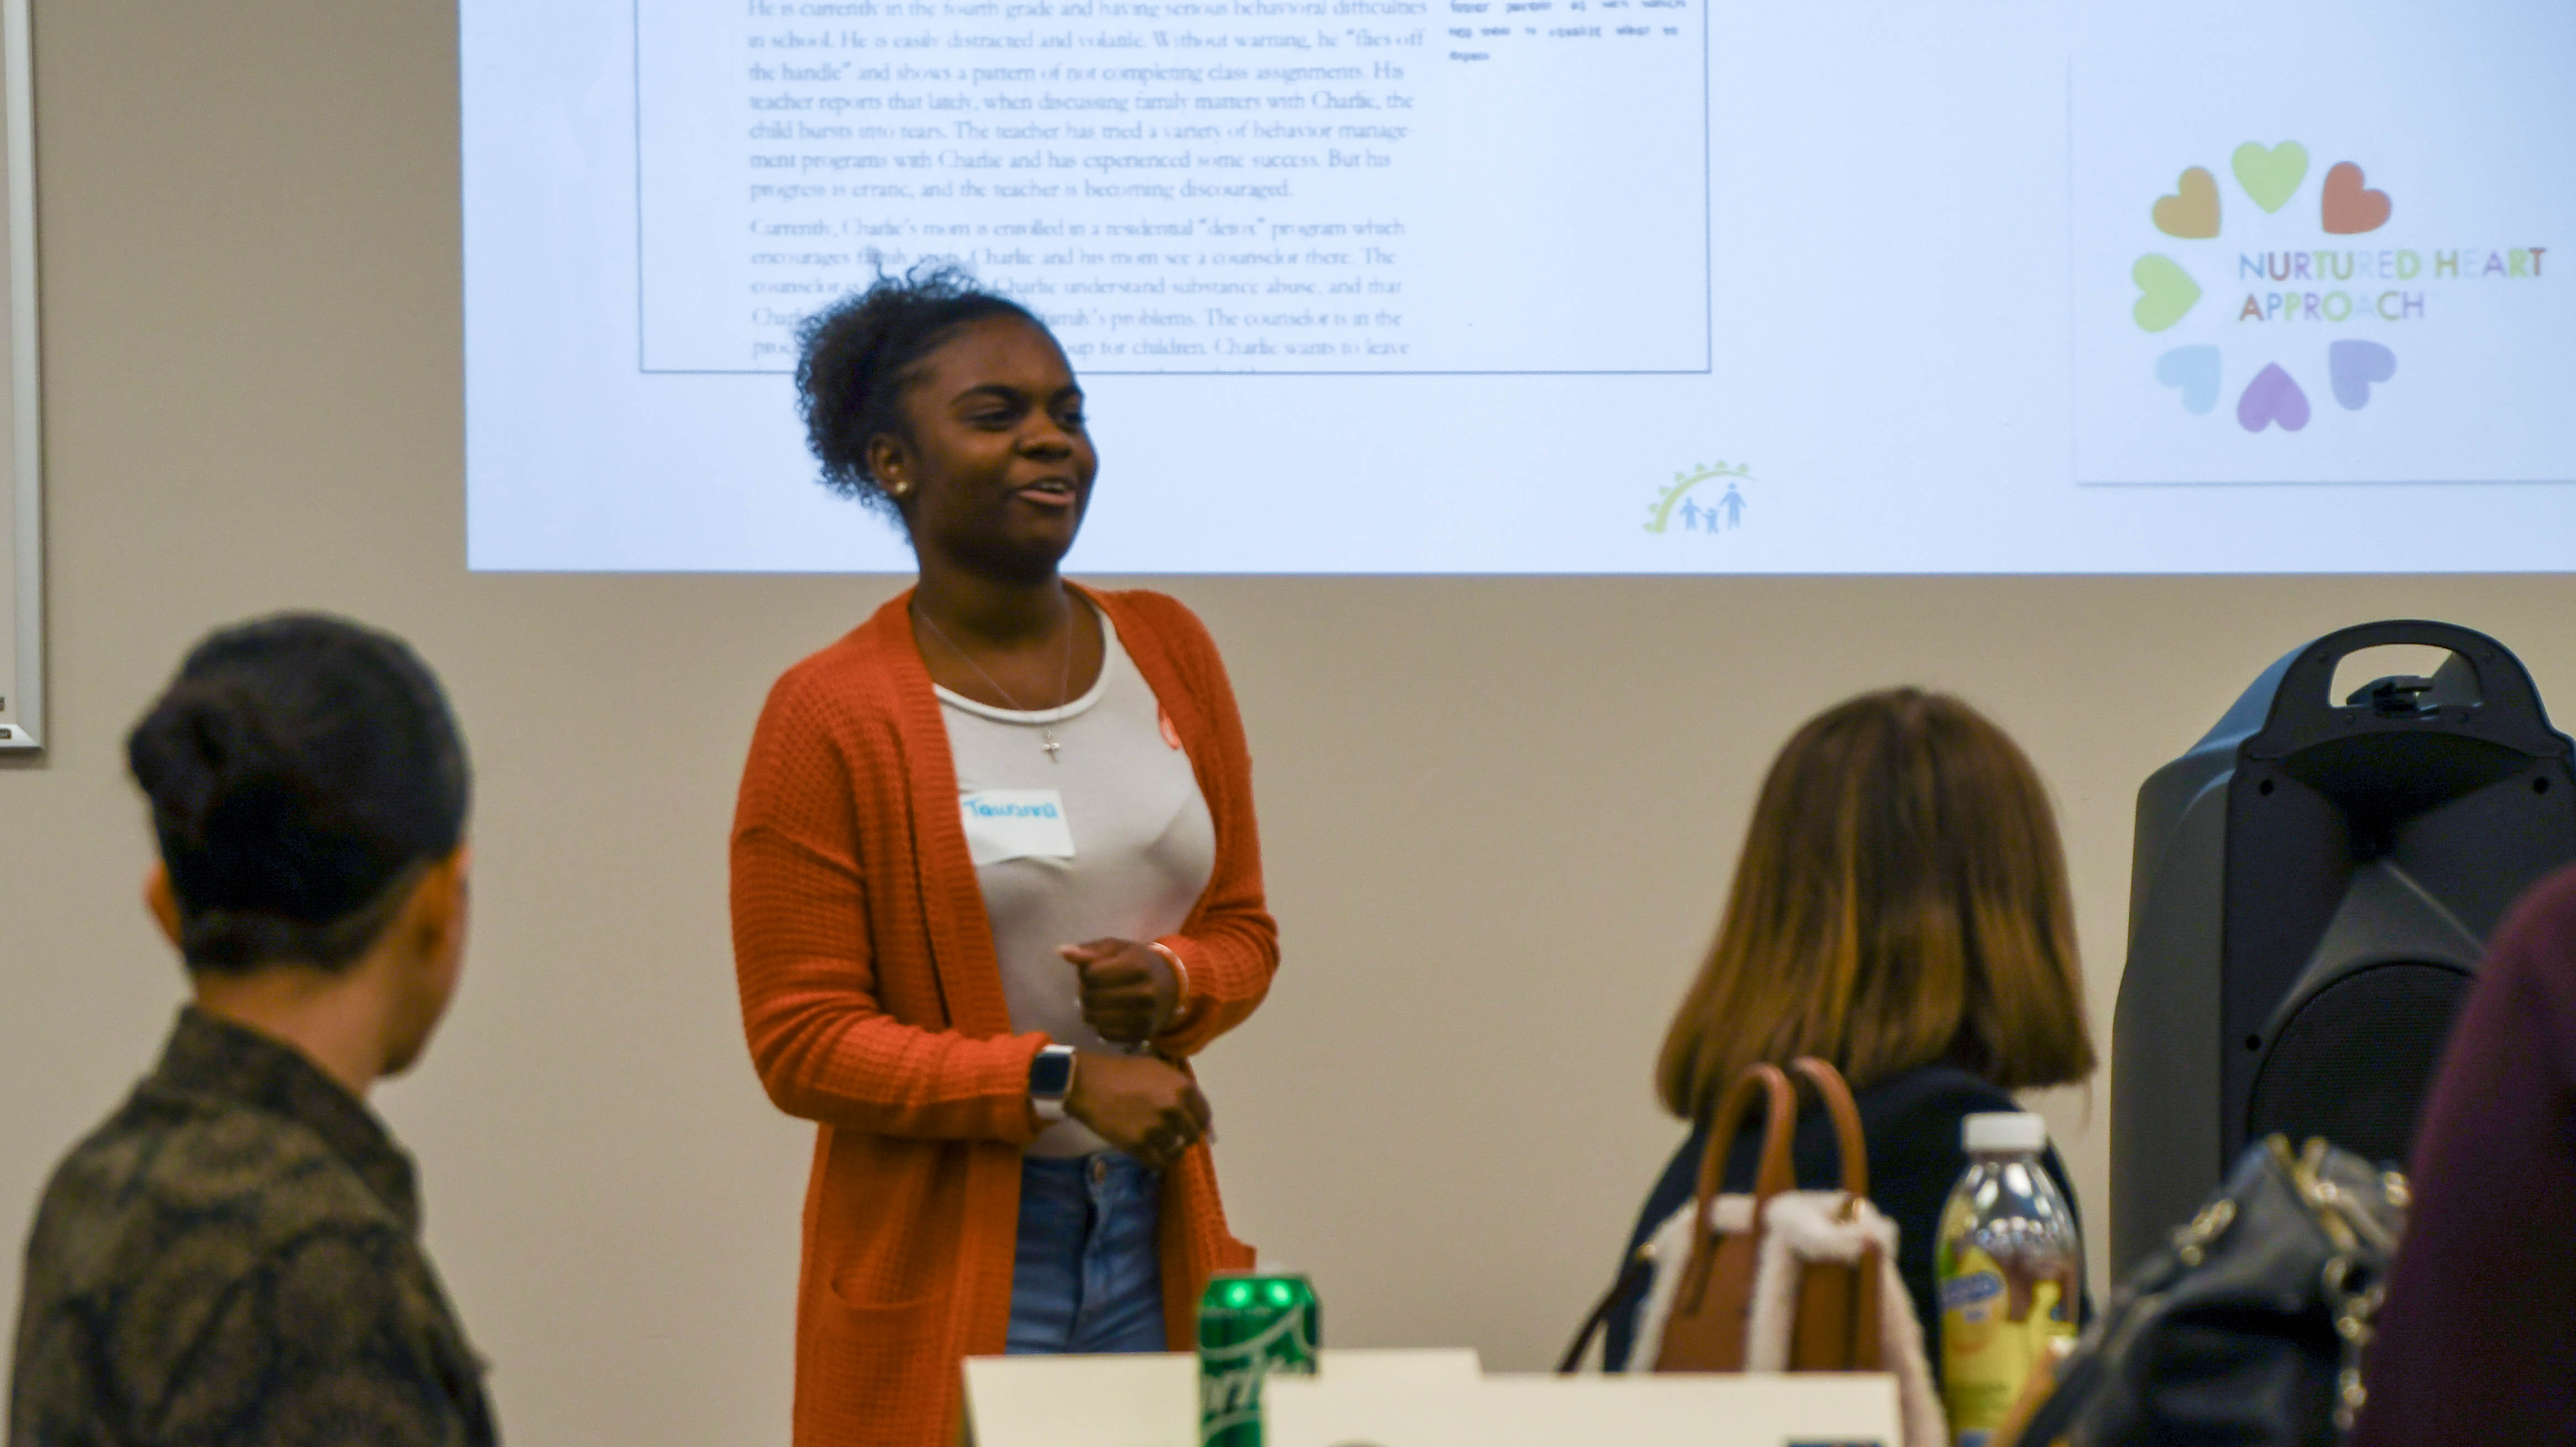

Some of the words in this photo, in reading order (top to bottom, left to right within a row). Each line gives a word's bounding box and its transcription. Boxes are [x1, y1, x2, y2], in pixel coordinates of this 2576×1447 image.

[748, 36, 765, 48] in
[841, 31, 866, 48] He
[876, 38, 887, 47] is
[893, 33, 937, 48] easily
[947, 32, 1033, 48] distracted
[1040, 31, 1072, 48] and
[1153, 30, 1227, 47] Without
[1318, 30, 1337, 47] he
[1396, 31, 1423, 46] off
[749, 62, 774, 80] the
[858, 64, 890, 81] and
[897, 64, 951, 80] shows
[959, 69, 967, 80] a
[973, 67, 1035, 86] pattern
[1041, 66, 1060, 80] of
[1067, 68, 1096, 80] not
[1102, 66, 1203, 86] completing
[1208, 64, 1248, 80] class
[1374, 61, 1404, 79] His
[750, 92, 814, 110] teacher
[819, 97, 882, 116] reports
[888, 92, 922, 109] that
[983, 92, 1032, 110] when
[1039, 92, 1129, 112] discussing
[1135, 92, 1188, 110] family
[1195, 97, 1260, 109] matters
[1267, 93, 1305, 108] with
[1386, 91, 1413, 108] the
[749, 121, 793, 139] child
[799, 121, 852, 139] bursts
[859, 127, 894, 139] into
[955, 120, 988, 139] The
[996, 123, 1059, 139] teacher
[1066, 123, 1094, 139] has
[1102, 121, 1142, 139] tried
[1150, 128, 1157, 139] a
[1165, 126, 1220, 139] variety
[1228, 124, 1246, 137] of
[1254, 121, 1333, 139] behavior
[751, 155, 796, 168] ment
[802, 155, 887, 172] programs
[893, 151, 931, 168] with
[938, 150, 1001, 168] Charlie
[1010, 150, 1041, 168] and
[1048, 150, 1076, 168] has
[1083, 150, 1191, 174] experienced
[1197, 155, 1243, 168] some
[1328, 149, 1360, 167] But
[1366, 150, 1391, 167] his
[751, 185, 825, 202] progress
[833, 186, 845, 196] is
[922, 181, 953, 197] and
[960, 179, 986, 197] the
[994, 181, 1059, 197] teacher
[1066, 186, 1077, 196] is
[1085, 180, 1174, 201] becoming
[924, 224, 970, 235] mom
[977, 225, 988, 234] is
[993, 219, 1064, 236] enrolled
[1069, 224, 1085, 235] in
[1092, 226, 1099, 235] a
[1106, 218, 1193, 236] residential
[1272, 224, 1347, 241] program
[1353, 219, 1405, 235] which
[752, 254, 850, 266] encourages
[969, 248, 1032, 266] Charlie
[1043, 248, 1073, 265] and
[1081, 250, 1104, 264] his
[1111, 253, 1158, 264] mom
[1165, 254, 1189, 265] see
[1198, 254, 1206, 264] a
[1212, 249, 1298, 265] counselor
[1366, 247, 1393, 264] The
[2239, 248, 2421, 281] NURTURED
[2435, 247, 2547, 279] HEART
[751, 280, 839, 293] counselor
[1065, 277, 1165, 293] understand
[1172, 281, 1256, 293] substance
[1329, 277, 1361, 293] and
[1368, 281, 1401, 293] that
[1207, 308, 1238, 327] The
[1244, 309, 1328, 326] counselor
[1334, 314, 1347, 324] is
[1354, 314, 1369, 326] in
[1375, 309, 1402, 326] the
[2239, 291, 2425, 322] APPROACH
[1101, 342, 1125, 354] for
[1214, 338, 1276, 355] Charlie
[1285, 343, 1335, 355] wants
[1342, 343, 1359, 354] to
[1366, 344, 1409, 354] leave
